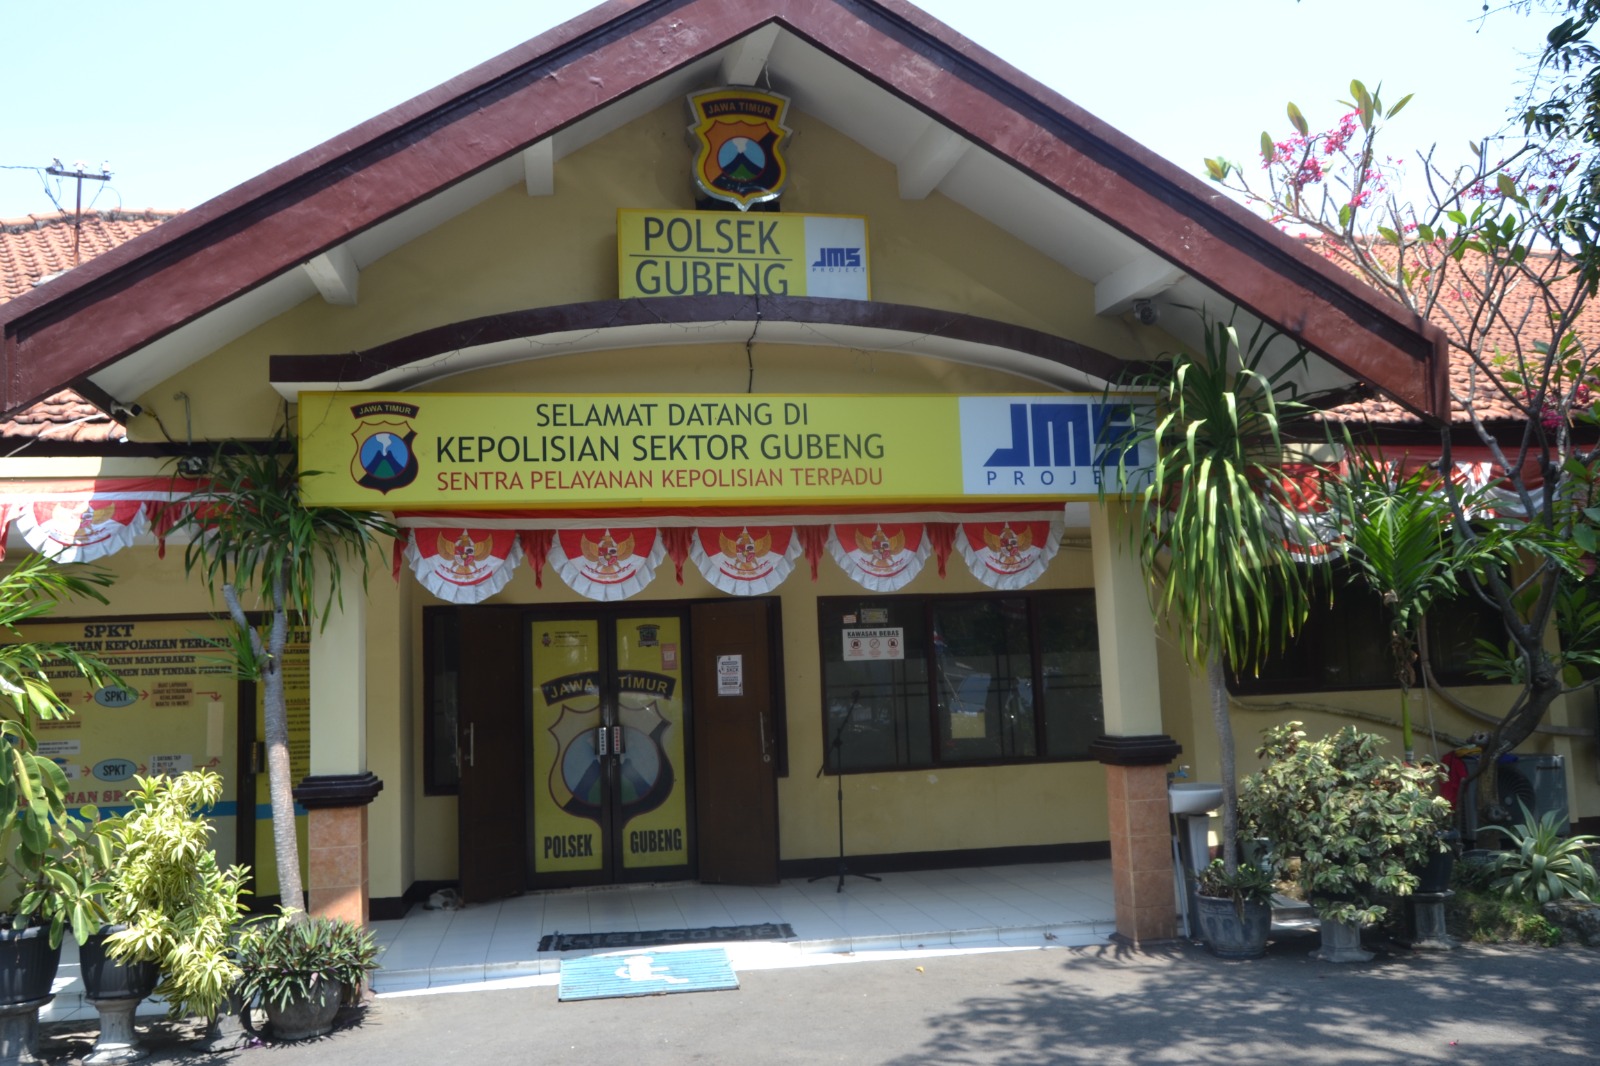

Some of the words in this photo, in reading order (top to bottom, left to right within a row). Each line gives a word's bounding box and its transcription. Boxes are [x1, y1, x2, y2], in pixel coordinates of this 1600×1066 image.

[708, 101, 736, 115] JAWA
[739, 101, 772, 116] TIMUR
[644, 217, 781, 255] POLSEK
[635, 259, 788, 297] GUBENG
[358, 405, 383, 415] JAWA
[384, 404, 412, 415] TIMUR
[536, 403, 658, 427] SELAMAT
[669, 402, 773, 427] DATANG
[784, 402, 808, 425] DI
[436, 435, 619, 463] KEPOLISIAN
[632, 434, 749, 462] SEKTOR
[760, 433, 885, 460] GUBENG
[436, 471, 523, 491] SENTRA
[531, 469, 653, 490] PELAYANAN
[662, 468, 782, 488] KEPOLISIAN
[790, 467, 883, 486] TERPADU
[987, 470, 1154, 486] PROJET
[84, 624, 135, 638] SPKT
[105, 638, 177, 651] KEPOLISIAN
[134, 655, 196, 665] MASYARAKAT
[141, 667, 160, 676] DAN
[161, 666, 197, 675] TINDAK
[550, 677, 595, 699] JAWA
[618, 675, 669, 694] TIMUR
[103, 764, 127, 777] SPKT
[543, 833, 593, 859] POLSEK
[629, 828, 683, 854] GUBENG
